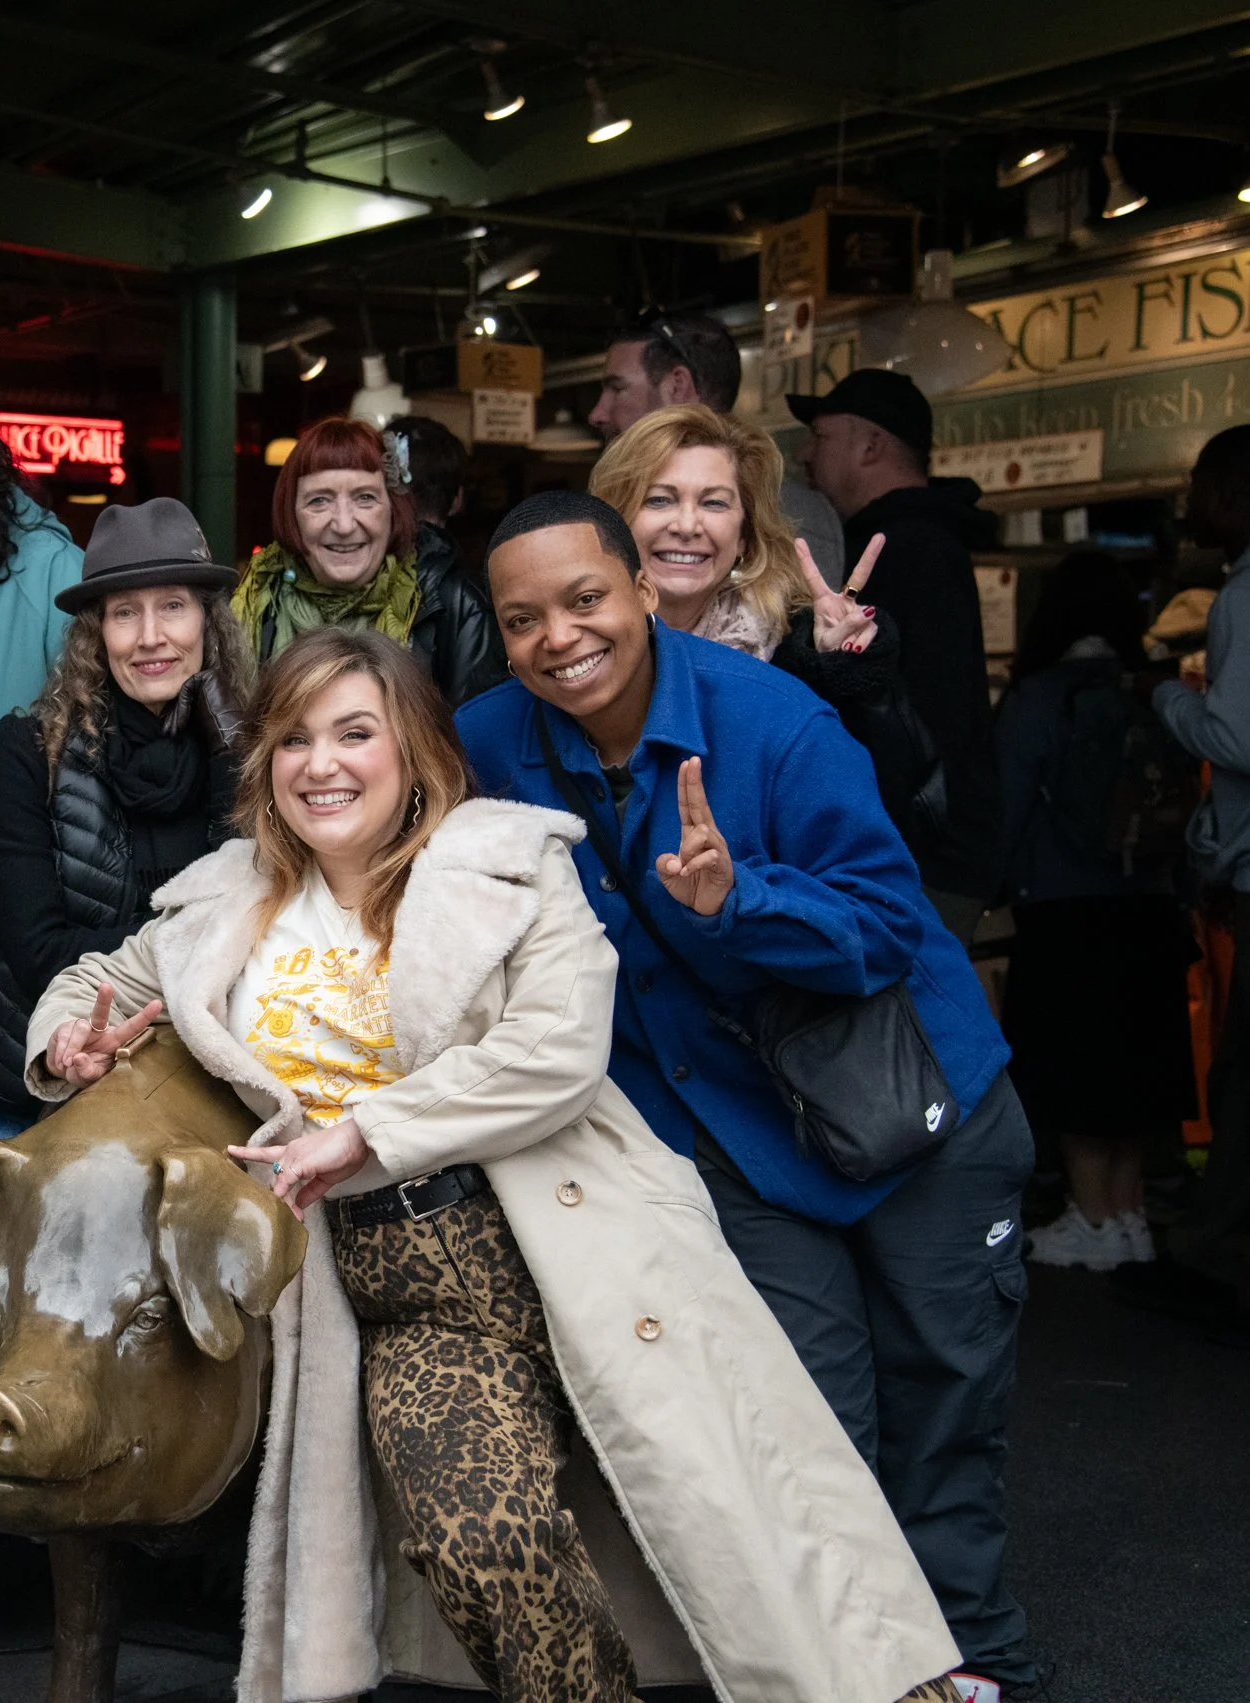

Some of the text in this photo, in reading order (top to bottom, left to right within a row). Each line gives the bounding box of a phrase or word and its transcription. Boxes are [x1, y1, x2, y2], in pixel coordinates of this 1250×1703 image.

[1130, 256, 1250, 352] FIS
[324, 993, 388, 1021] MARKET
[334, 1013, 394, 1035] CENTE
